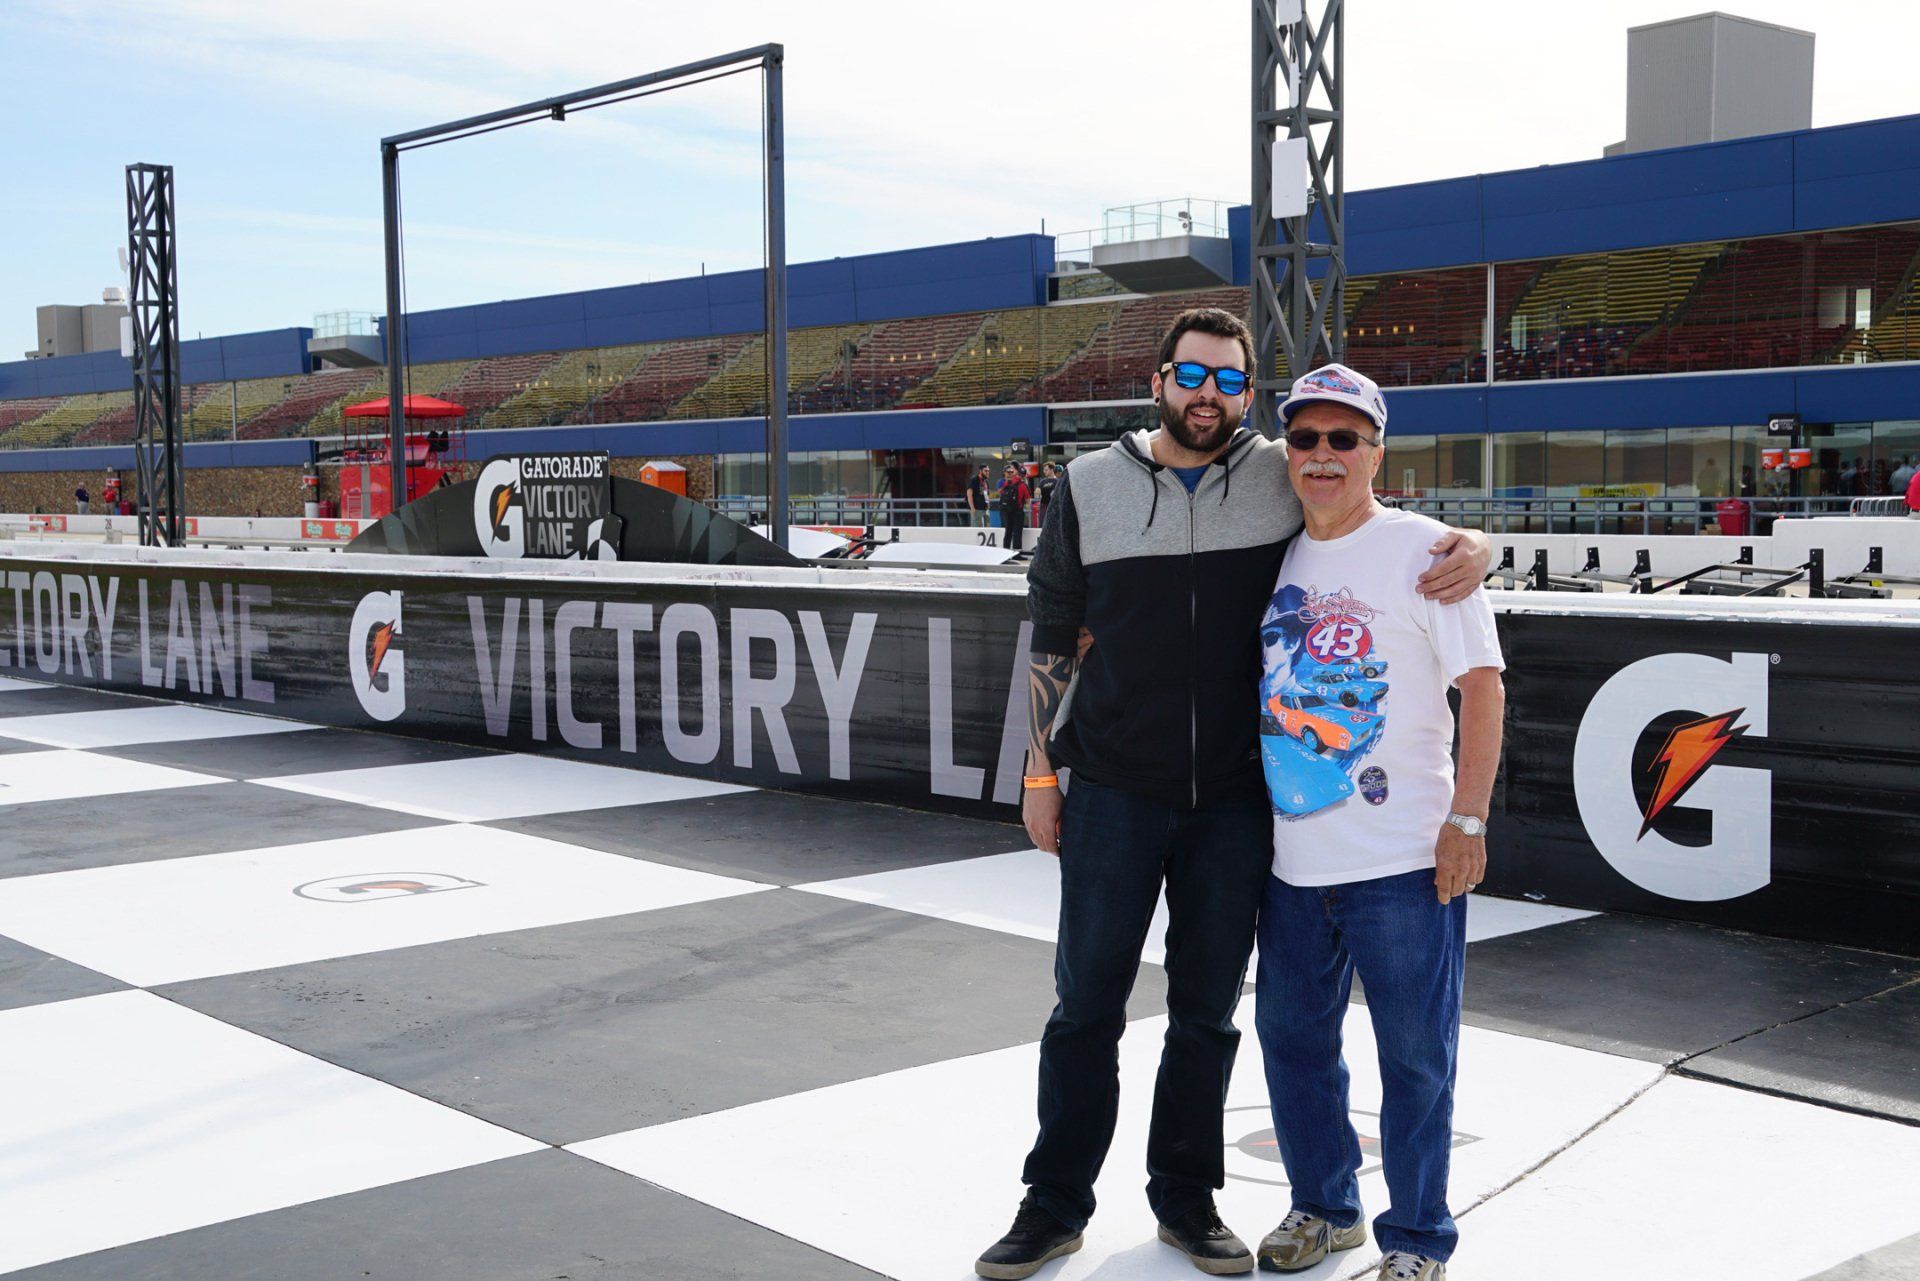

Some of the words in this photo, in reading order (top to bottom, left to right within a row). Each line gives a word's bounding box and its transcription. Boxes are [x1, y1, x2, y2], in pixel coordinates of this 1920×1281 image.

[523, 484, 604, 519] VICTORY
[526, 522, 574, 555] LANE
[977, 531, 997, 547] 24
[139, 578, 275, 704] LANE
[1312, 623, 1363, 657] 43
[466, 595, 878, 781] VICTORY
